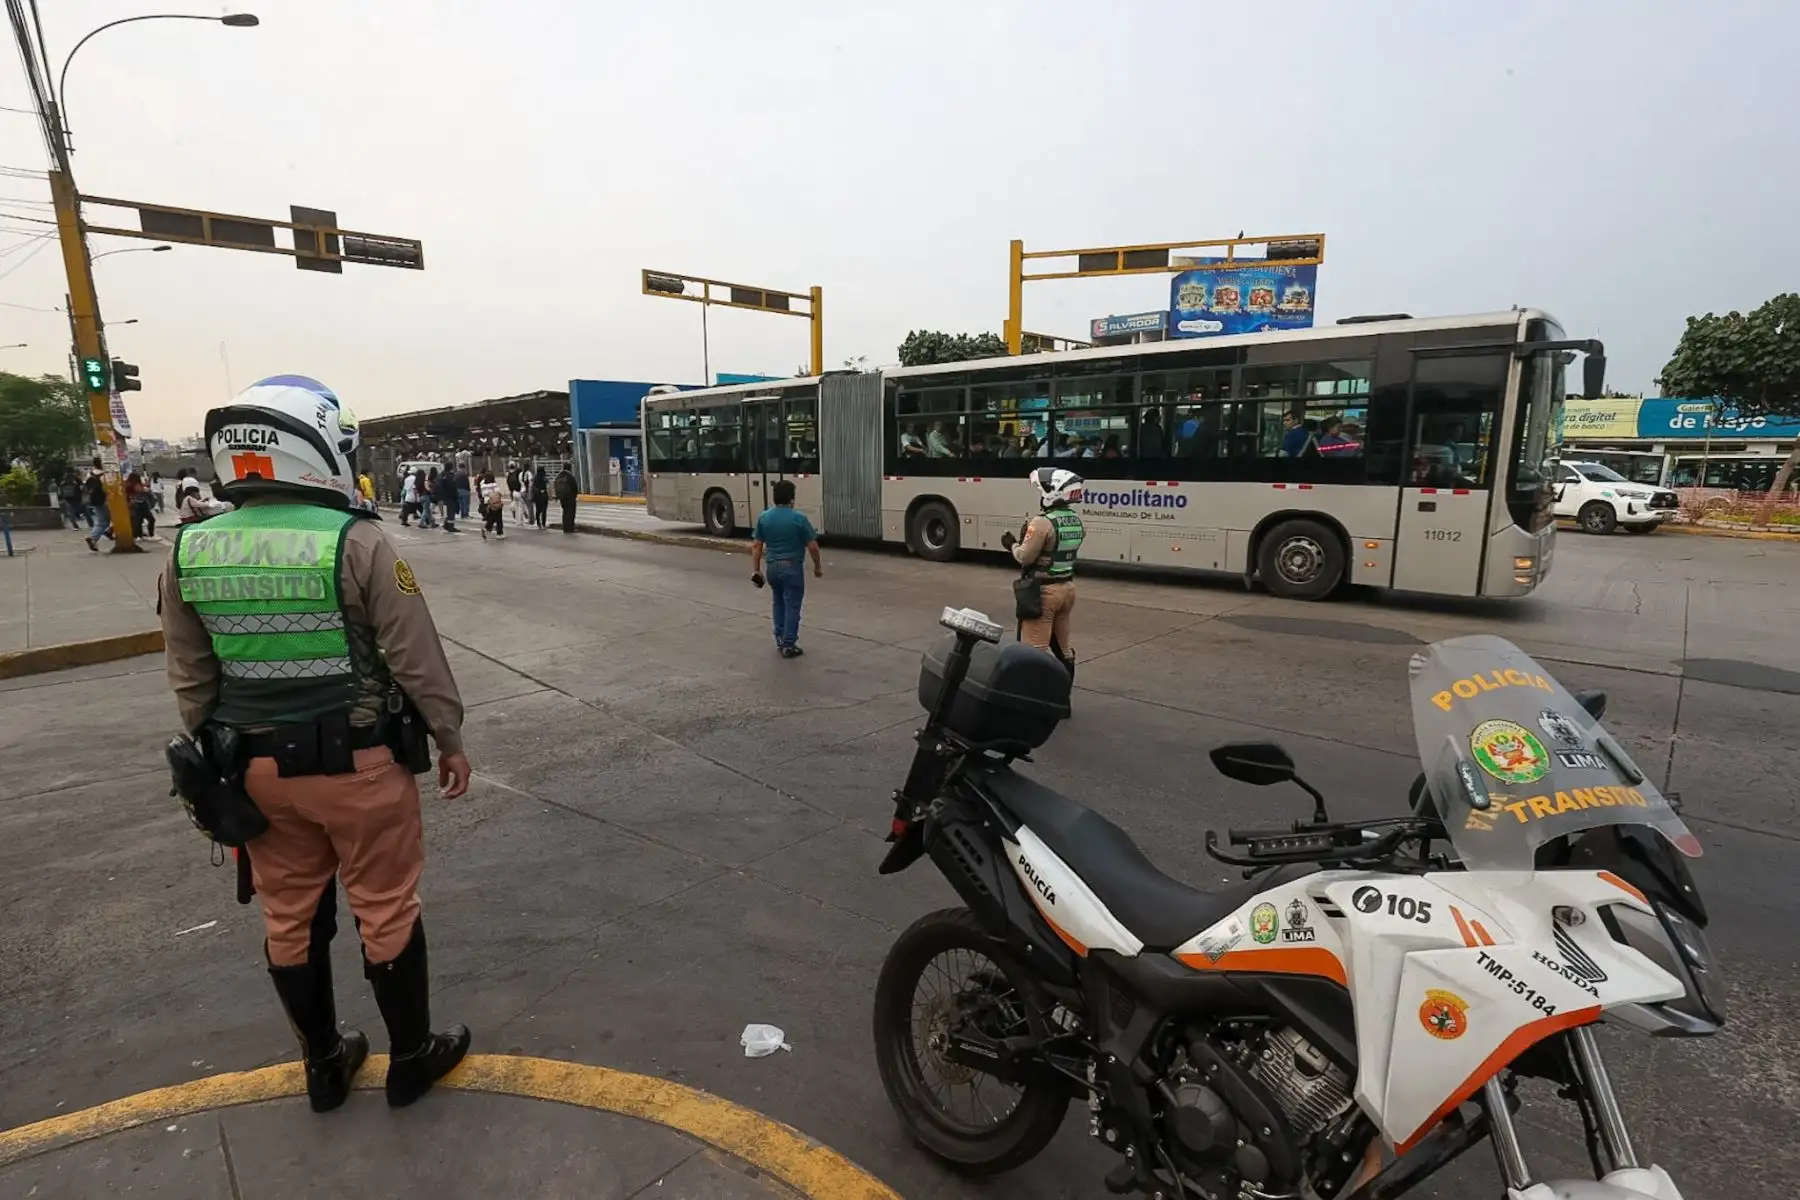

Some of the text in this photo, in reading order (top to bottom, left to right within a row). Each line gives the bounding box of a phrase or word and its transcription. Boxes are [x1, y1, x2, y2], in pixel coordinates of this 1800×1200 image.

[1100, 318, 1160, 333] SALVADOR
[86, 360, 101, 372] 36
[1578, 411, 1617, 424] digital
[1669, 414, 1697, 429] de
[217, 428, 280, 446] POLICIA
[1424, 530, 1462, 542] 11012
[187, 530, 318, 566] POLICIA
[185, 574, 324, 600] TRANSITO
[1431, 668, 1555, 712] POLICIA
[1559, 753, 1609, 770] LIMA
[1503, 785, 1649, 824] TRANSITO
[1019, 854, 1056, 906] POLICÍA
[1386, 894, 1432, 924] 105
[1282, 931, 1315, 942] LIMA
[1475, 951, 1557, 1017] TMP:5184
[1531, 950, 1601, 999] HONDA
